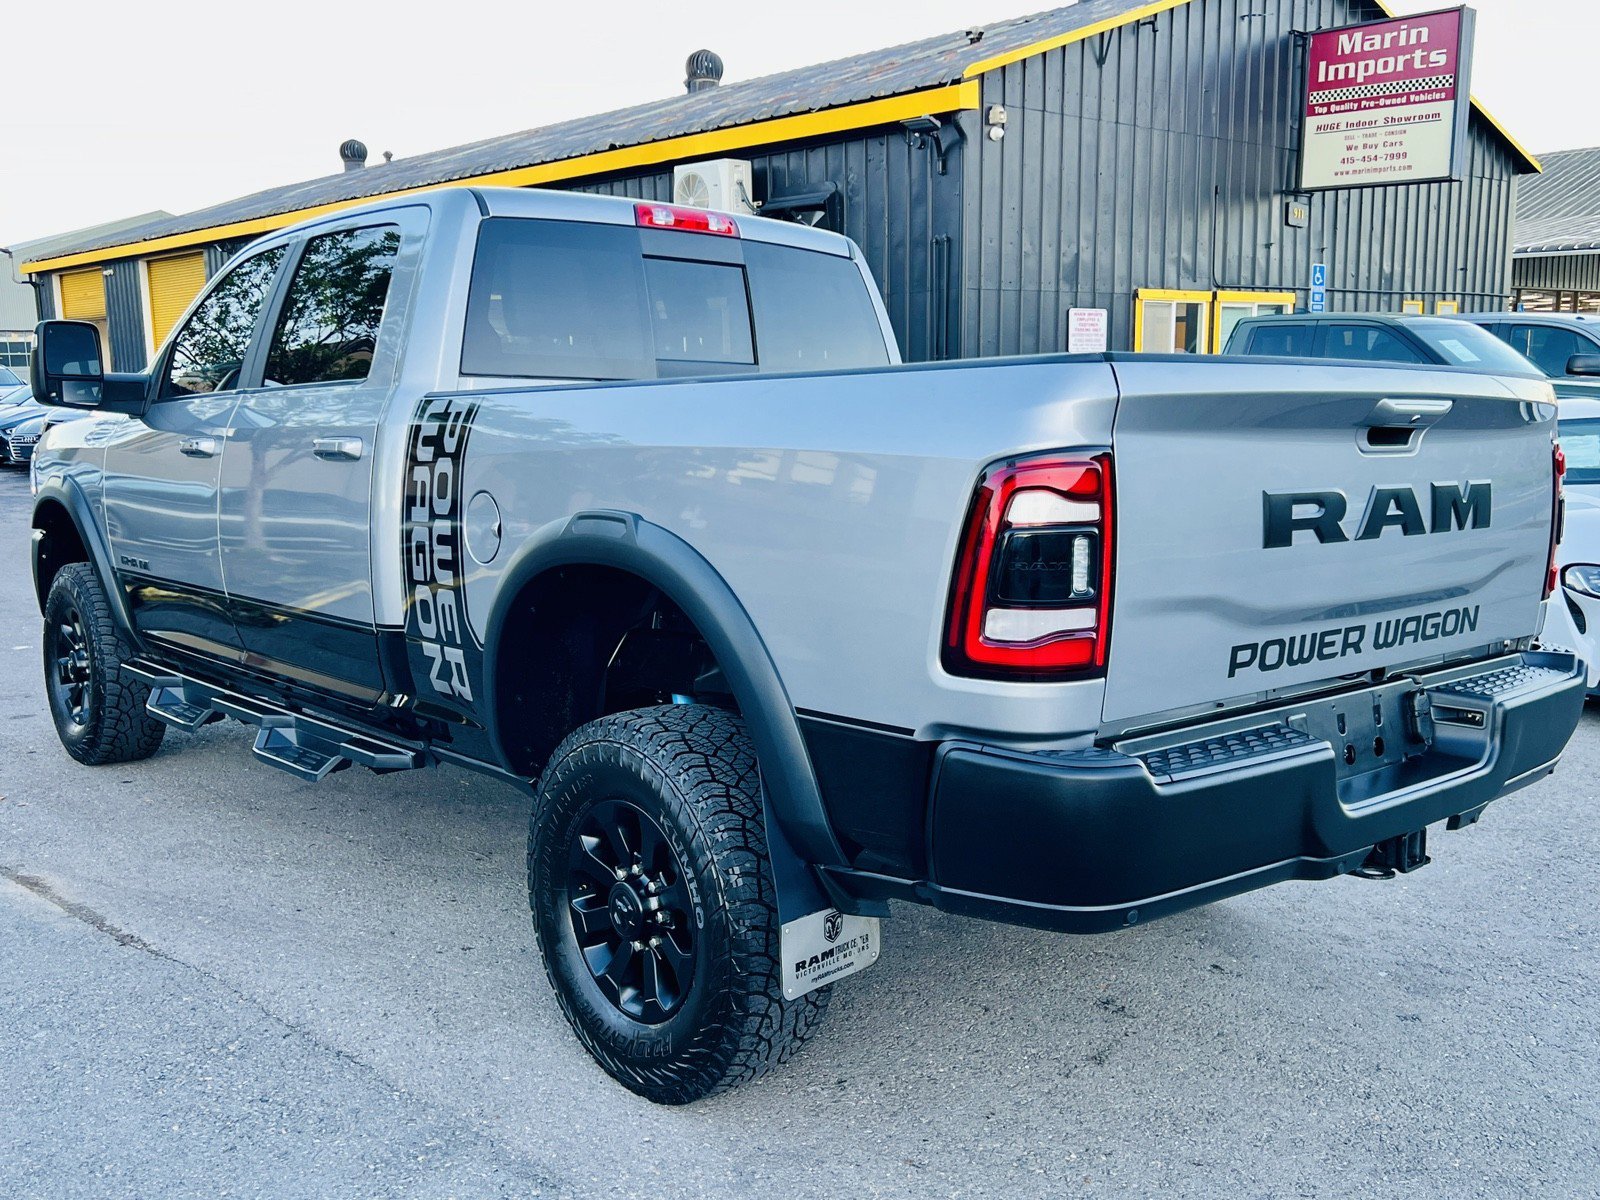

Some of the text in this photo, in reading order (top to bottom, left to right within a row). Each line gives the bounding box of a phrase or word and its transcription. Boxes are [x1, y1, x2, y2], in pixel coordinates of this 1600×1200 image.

[1337, 25, 1429, 55] Marin
[1318, 49, 1447, 83] Imports
[1314, 91, 1446, 115] Top Quality Pre-Owned Vehicles
[1316, 111, 1441, 133] HUGE Indoor Showroom
[1346, 140, 1404, 152] We Buy Cars
[1362, 132, 1378, 140] TRADE
[1334, 164, 1413, 177] www.marinimports.com
[1340, 152, 1408, 165] 415-454-7999
[1262, 479, 1492, 549] RAM
[411, 399, 453, 695] WAGON
[432, 399, 473, 702] POWER
[120, 555, 151, 571] RAM
[1227, 604, 1481, 678] POWER WAGON
[795, 947, 835, 973] RAM
[835, 941, 850, 956] TRUCK
[796, 943, 869, 980] VICTORVILLE MOORS
[811, 961, 855, 984] myRAMtrucks.com
